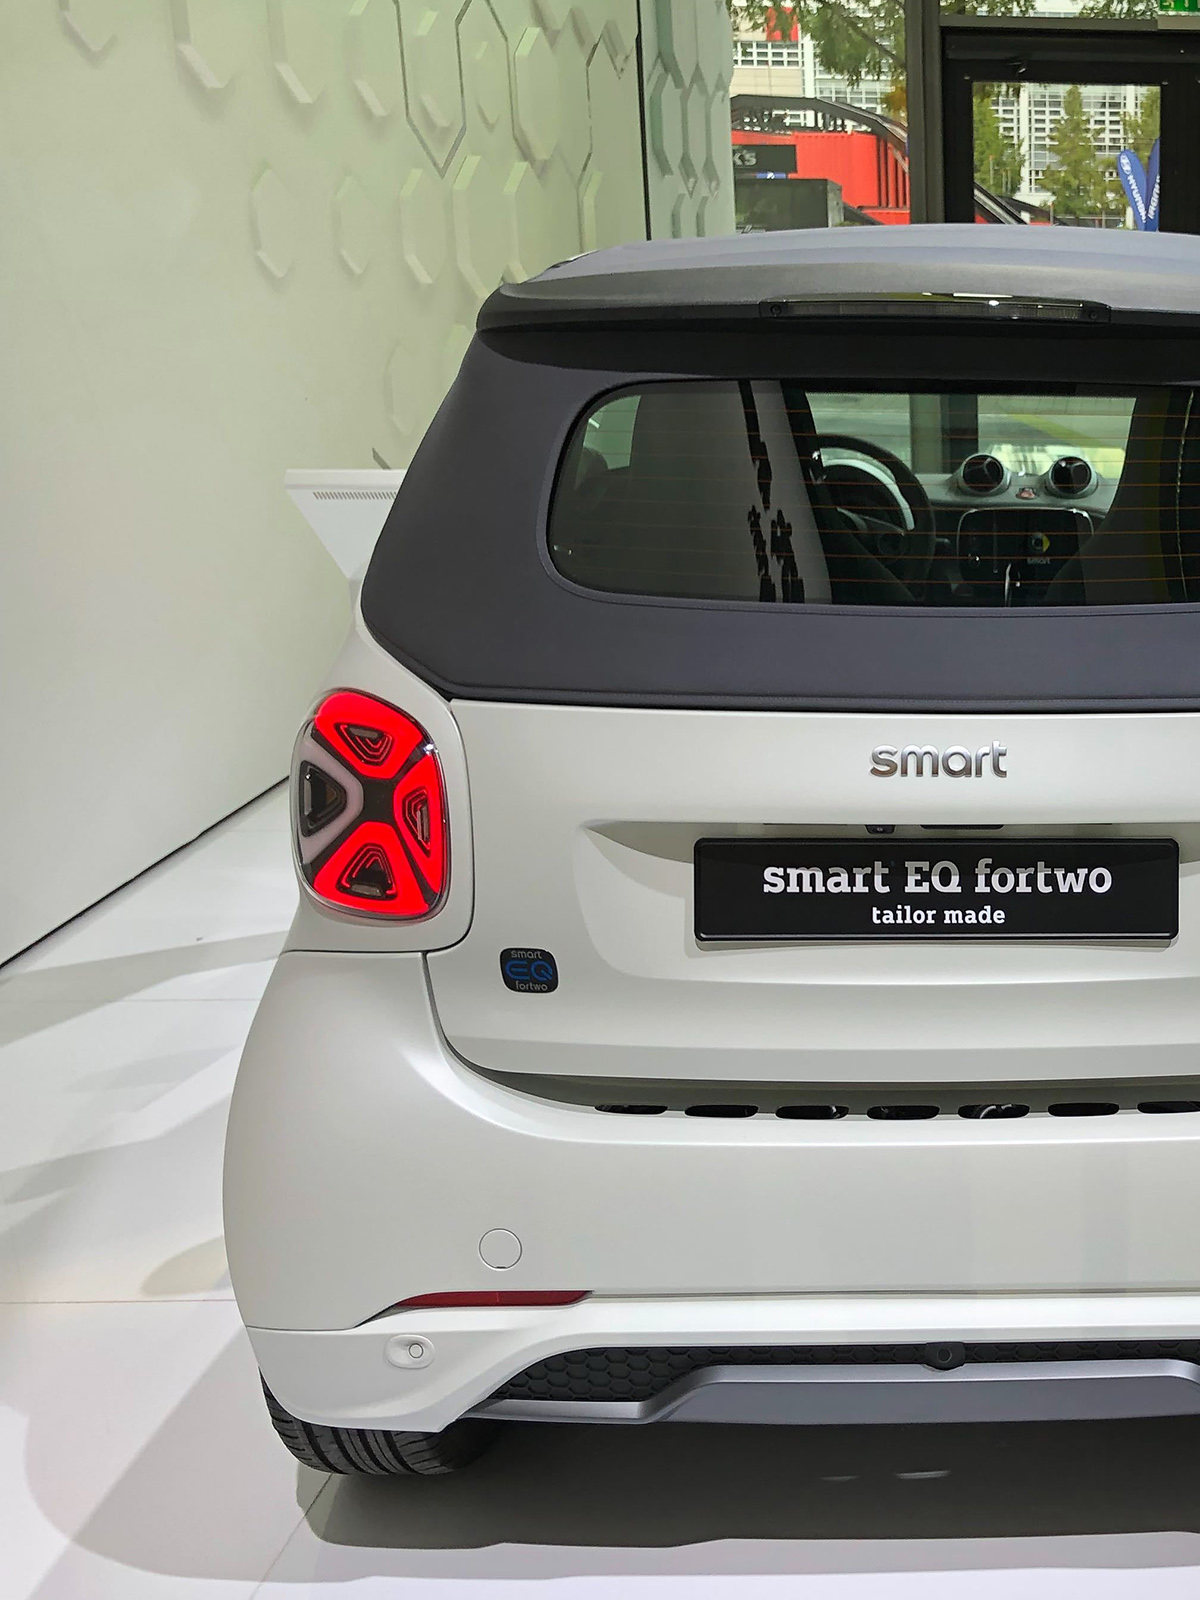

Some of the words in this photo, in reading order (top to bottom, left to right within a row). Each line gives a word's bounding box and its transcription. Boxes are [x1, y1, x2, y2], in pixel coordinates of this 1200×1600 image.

[870, 740, 1008, 778] smart
[763, 860, 891, 894] smart
[904, 860, 962, 894] EQ
[974, 857, 1113, 894] fortwo
[872, 905, 937, 925] tailor
[943, 905, 1006, 925] made
[511, 950, 543, 959] smart
[505, 960, 553, 981] EQ
[515, 980, 548, 991] fortwo
